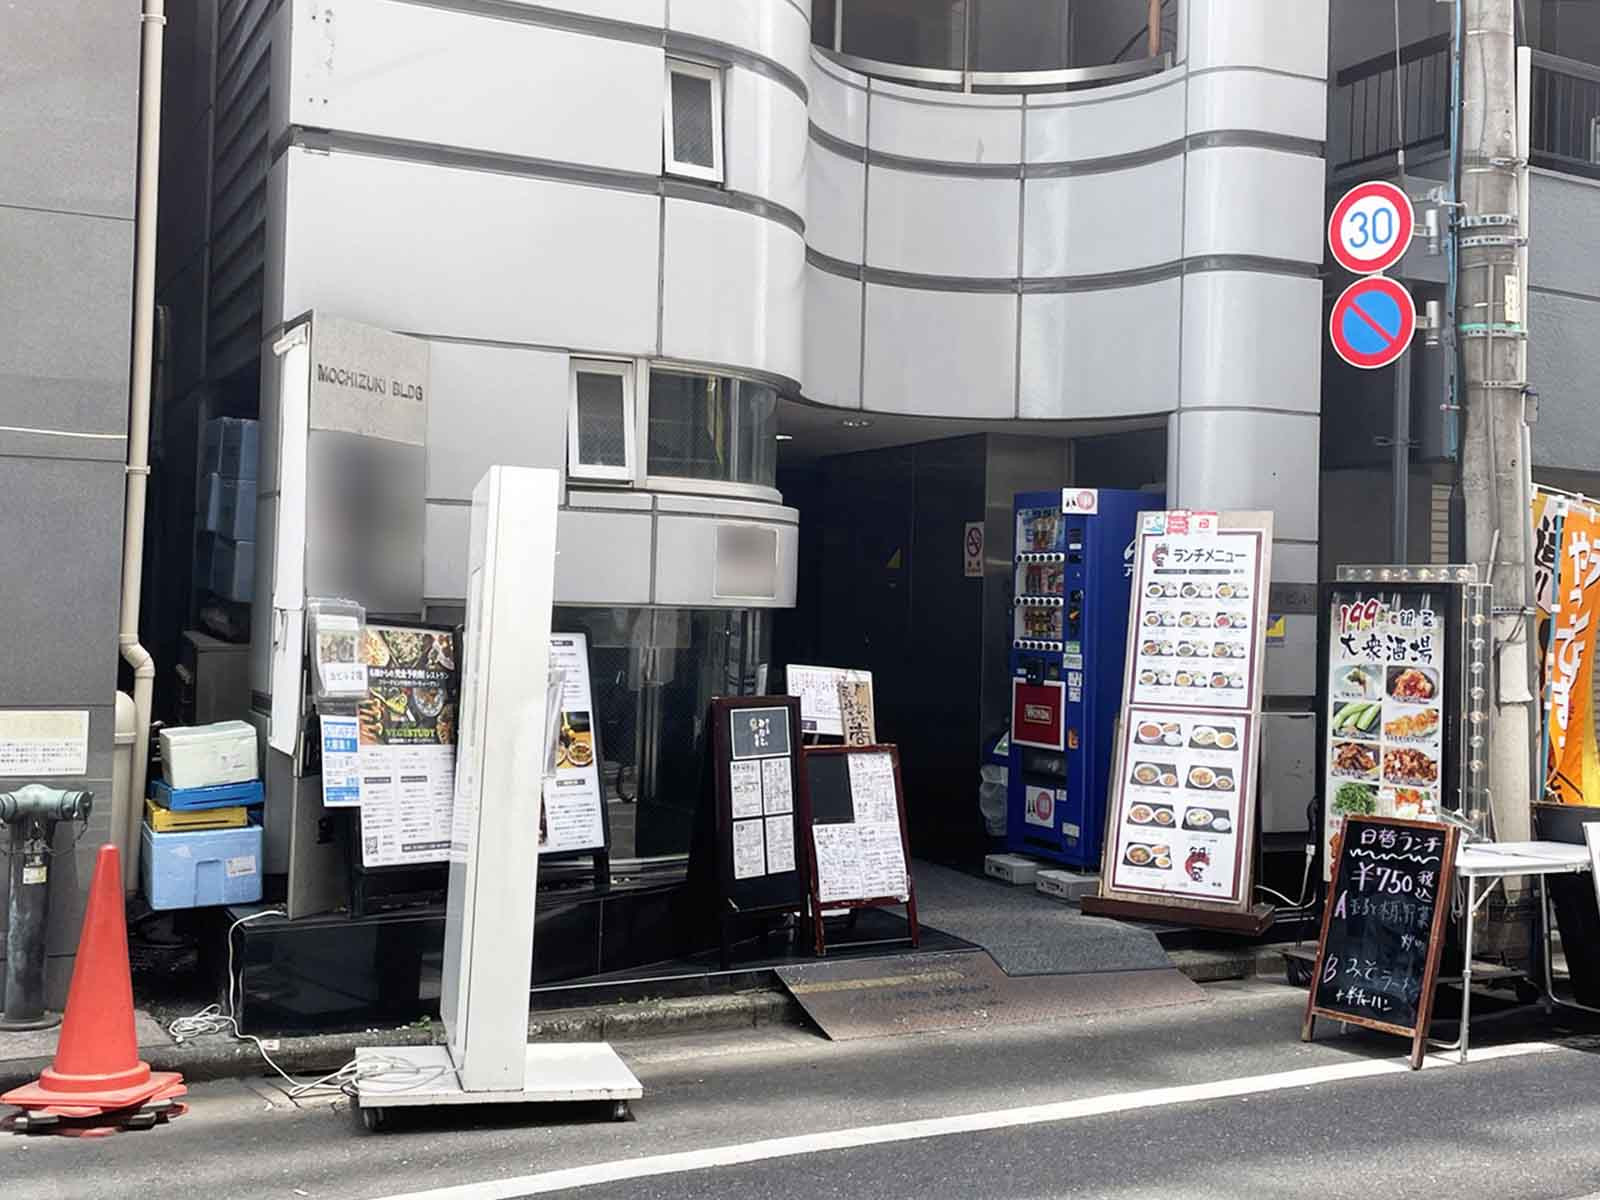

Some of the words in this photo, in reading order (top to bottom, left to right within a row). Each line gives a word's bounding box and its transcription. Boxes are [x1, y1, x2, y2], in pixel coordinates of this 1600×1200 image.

[1350, 207, 1393, 248] 30
[318, 363, 386, 394] MOCHIZUKI
[392, 380, 423, 401] BLDG
[1173, 548, 1247, 563] ランチメニュー
[1339, 632, 1433, 664] 大衆酒場
[1360, 828, 1441, 853] 日替ランチ
[1351, 861, 1413, 894] ¥750
[1334, 889, 1348, 919] A
[1323, 953, 1338, 983] B
